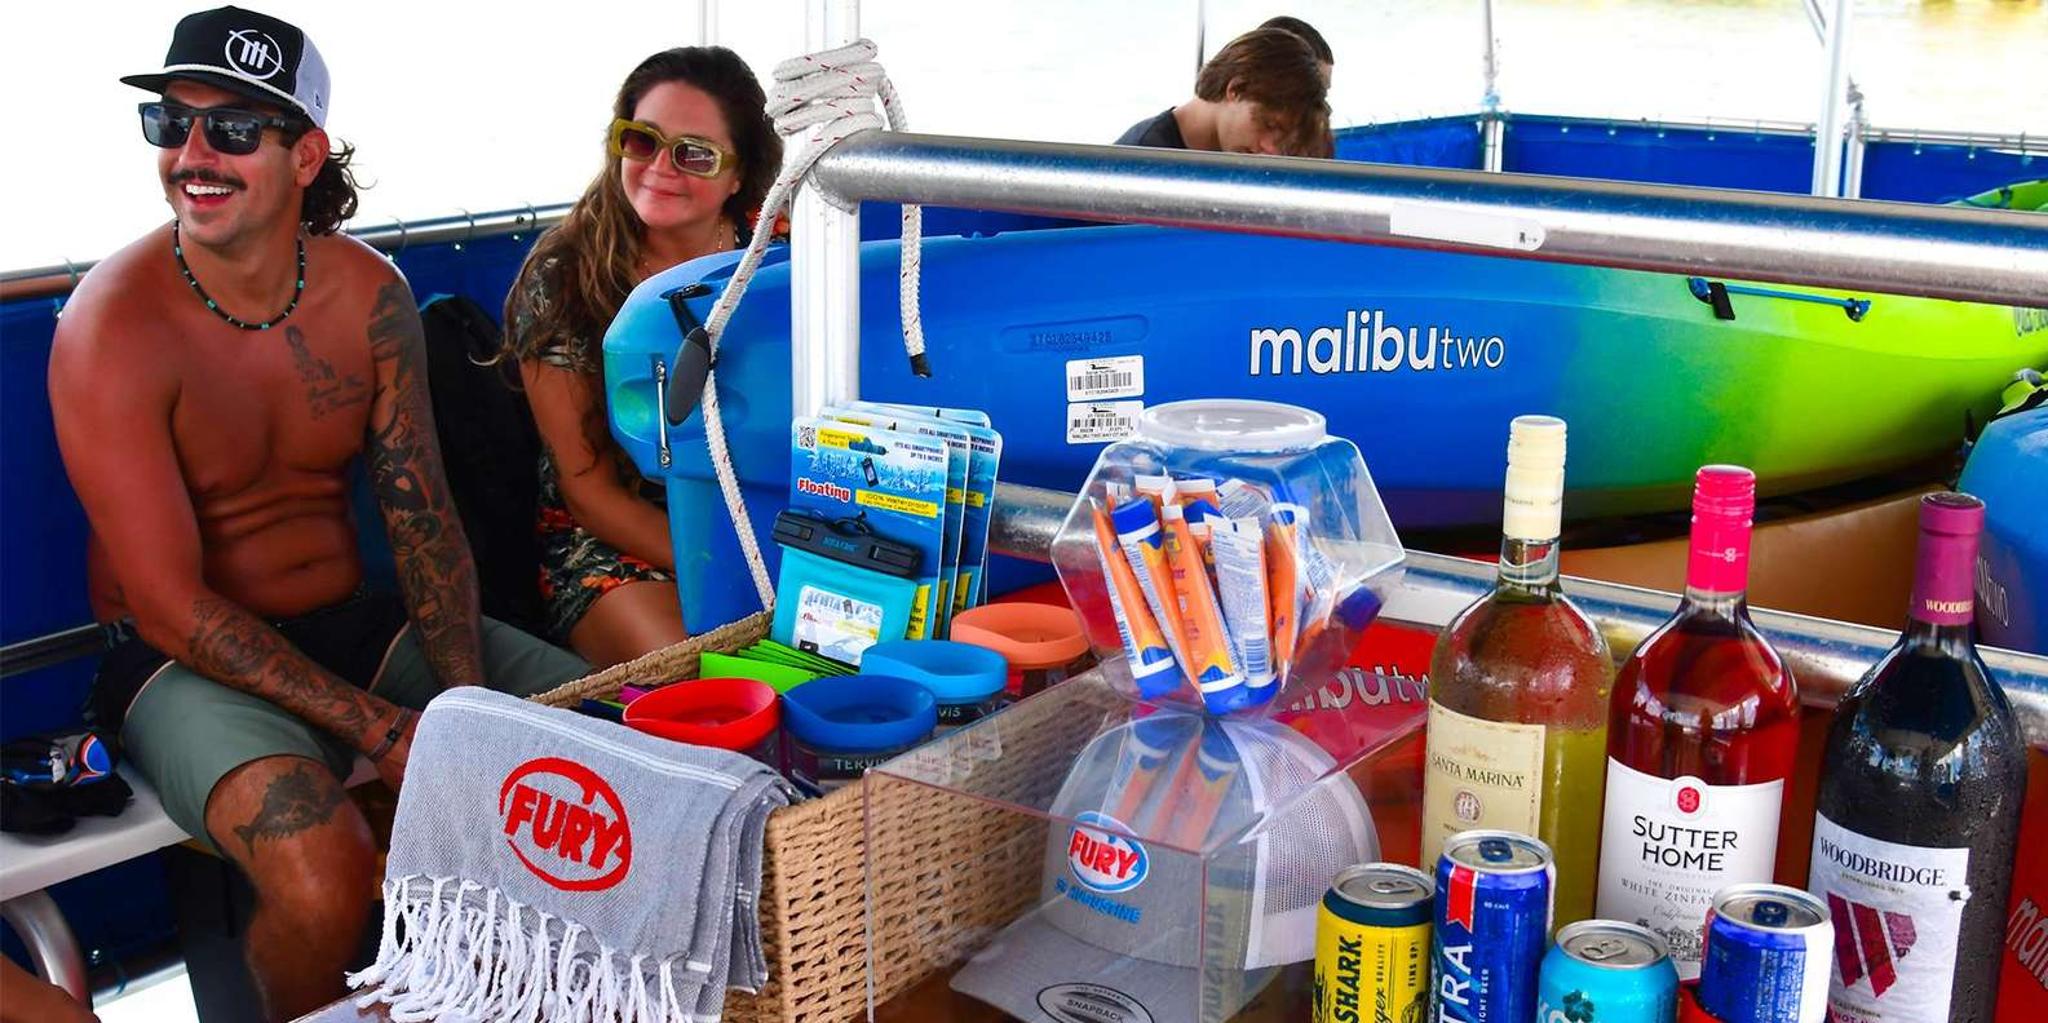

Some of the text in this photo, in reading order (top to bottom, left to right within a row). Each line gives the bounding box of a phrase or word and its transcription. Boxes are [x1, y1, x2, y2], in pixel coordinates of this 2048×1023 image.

[799, 478, 849, 501] Floating
[1431, 751, 1524, 788] SANTA MARINA
[503, 783, 622, 871] FURY
[1632, 815, 1738, 850] SUTTER
[1068, 829, 1140, 880] FURY
[1641, 842, 1724, 872] HOME
[1819, 837, 1945, 887] WOODBRIDGE
[1621, 878, 1713, 905] WHITE ZINFAN
[1333, 935, 1362, 1023] SHARK
